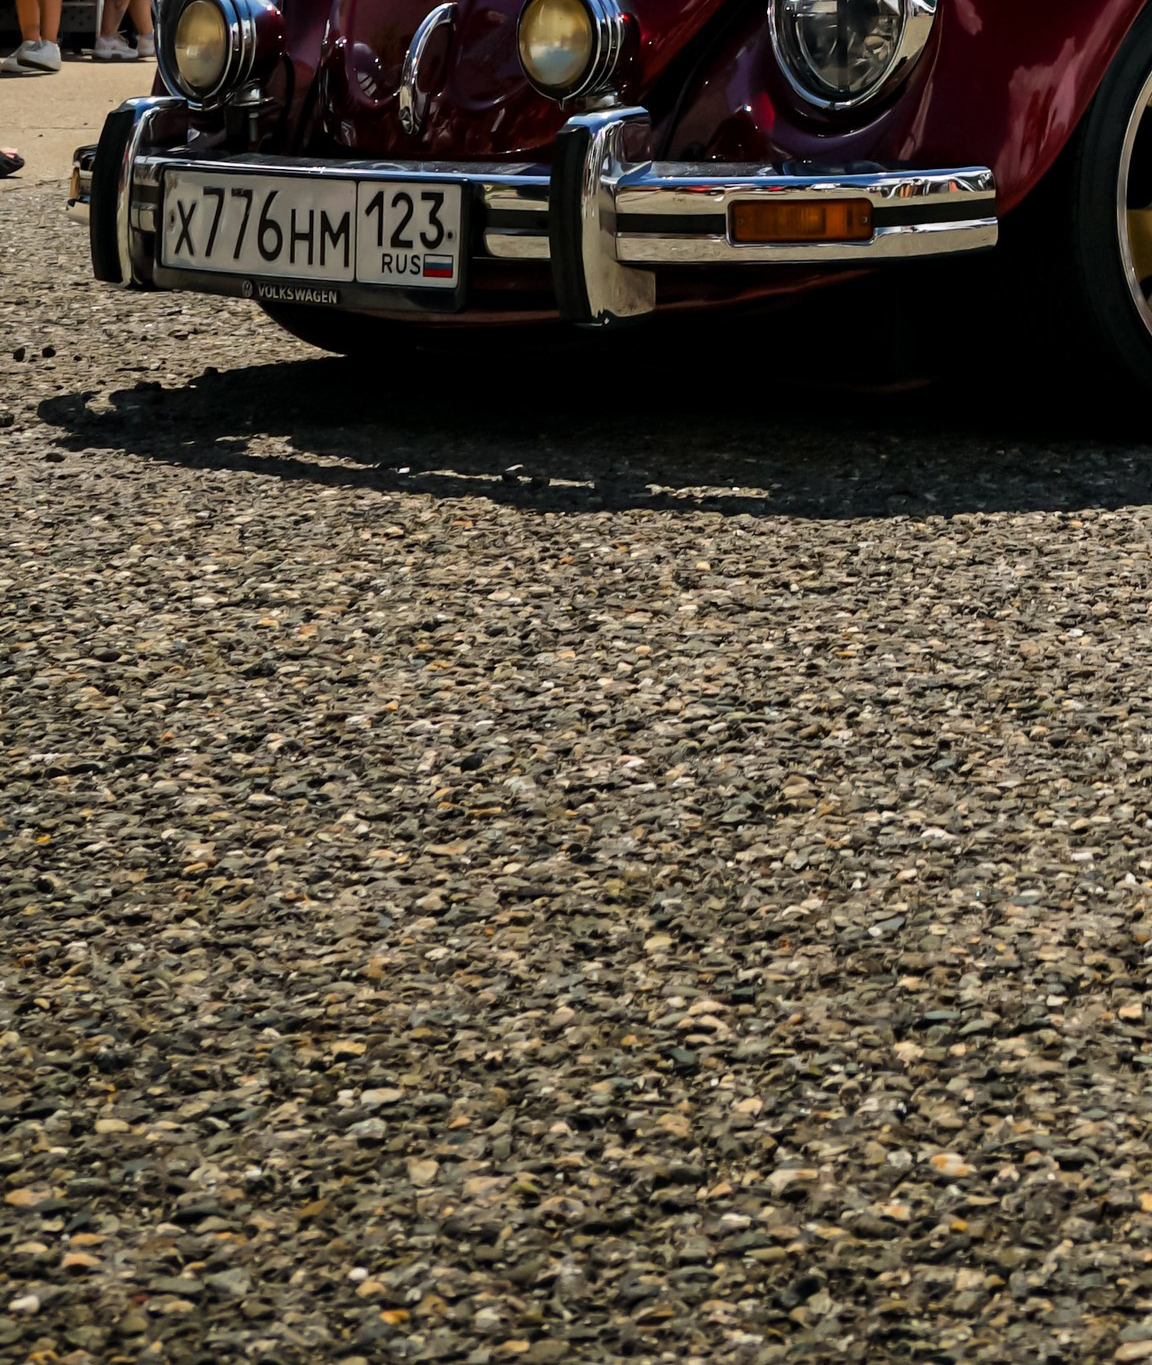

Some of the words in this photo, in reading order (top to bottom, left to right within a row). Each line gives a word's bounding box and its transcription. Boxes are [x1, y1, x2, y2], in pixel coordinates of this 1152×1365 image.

[365, 190, 446, 250] 123
[381, 253, 421, 275] RUS
[257, 285, 337, 304] VOLKSWAGEN
